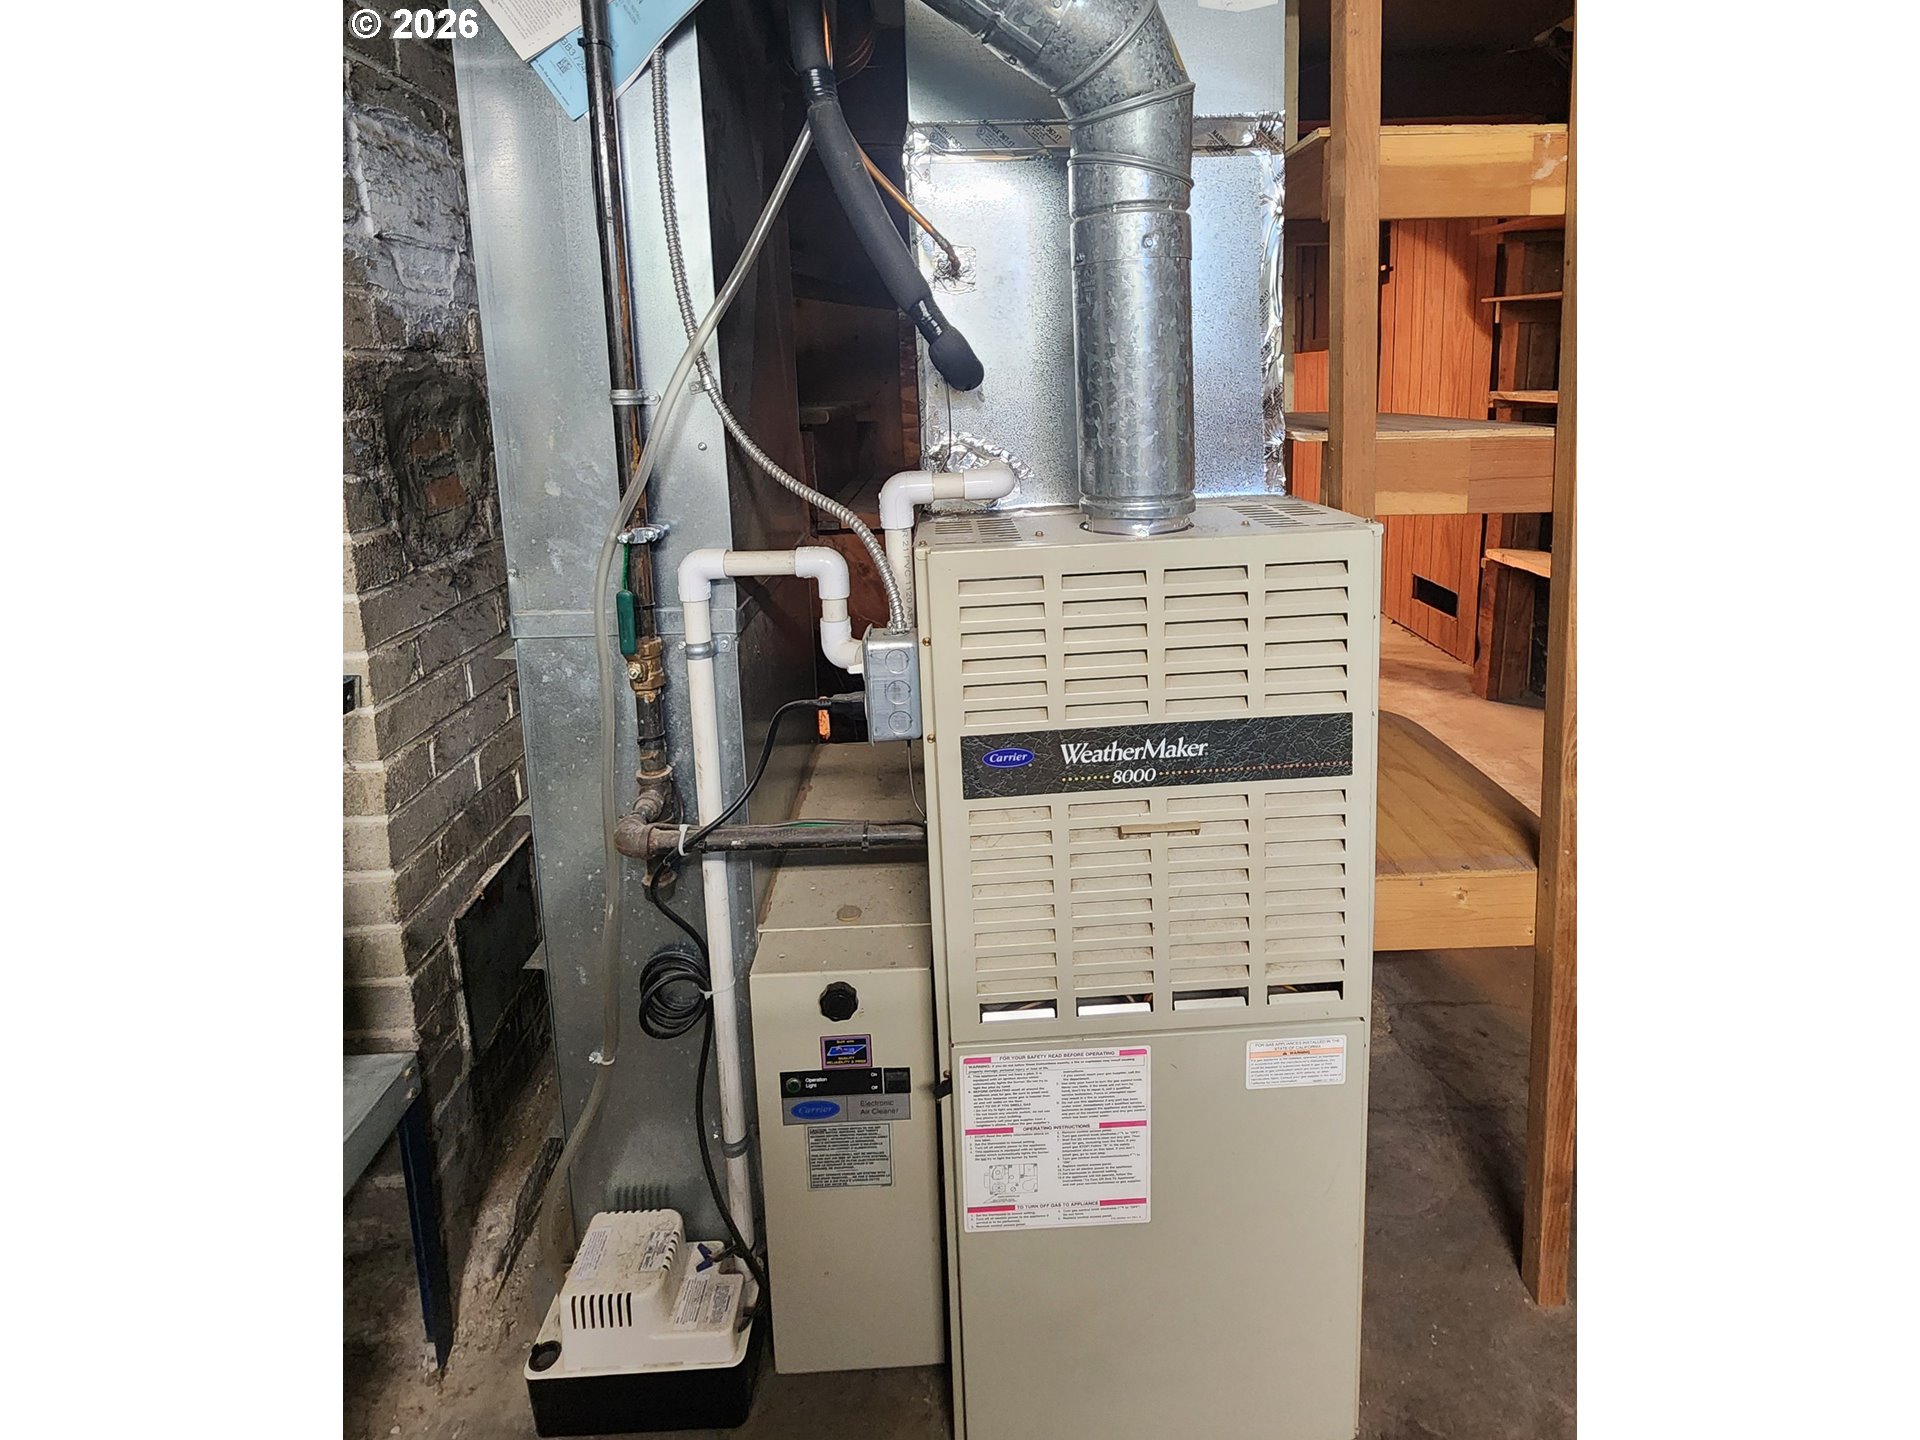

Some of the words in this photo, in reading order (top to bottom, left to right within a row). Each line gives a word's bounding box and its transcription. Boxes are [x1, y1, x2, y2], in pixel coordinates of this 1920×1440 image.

[1061, 736, 1206, 764] WeatherMaker
[988, 753, 1028, 763] Carrier
[1112, 768, 1156, 784] 8000
[799, 1106, 834, 1114] Carrier
